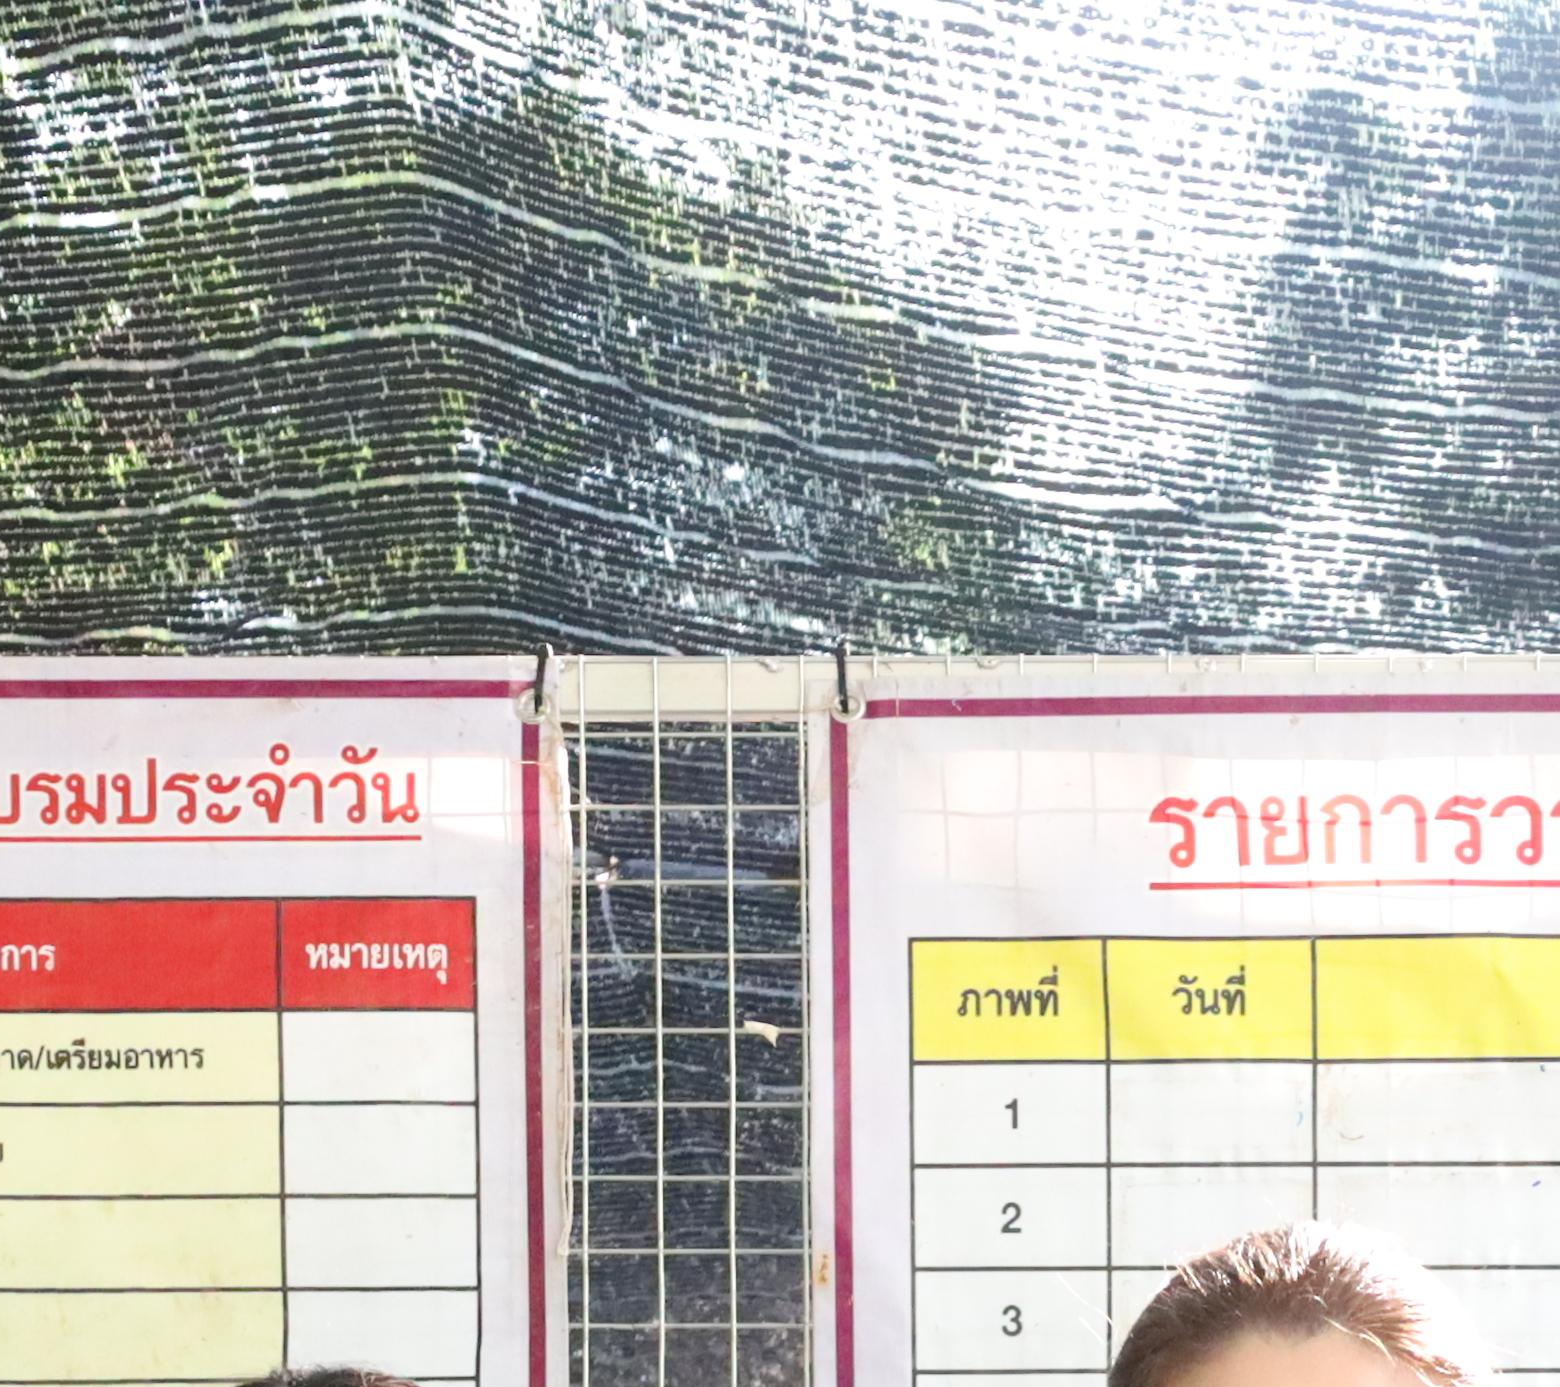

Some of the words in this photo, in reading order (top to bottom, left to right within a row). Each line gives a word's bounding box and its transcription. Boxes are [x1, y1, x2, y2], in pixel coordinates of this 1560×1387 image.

[304, 942, 448, 985] หมายเหตุ
[957, 965, 1059, 1017] ภาพที่
[1171, 965, 1246, 1016] วันที่
[1004, 1097, 1019, 1130] 1
[1000, 1201, 1022, 1234] 2
[1001, 1304, 1023, 1338] 3
